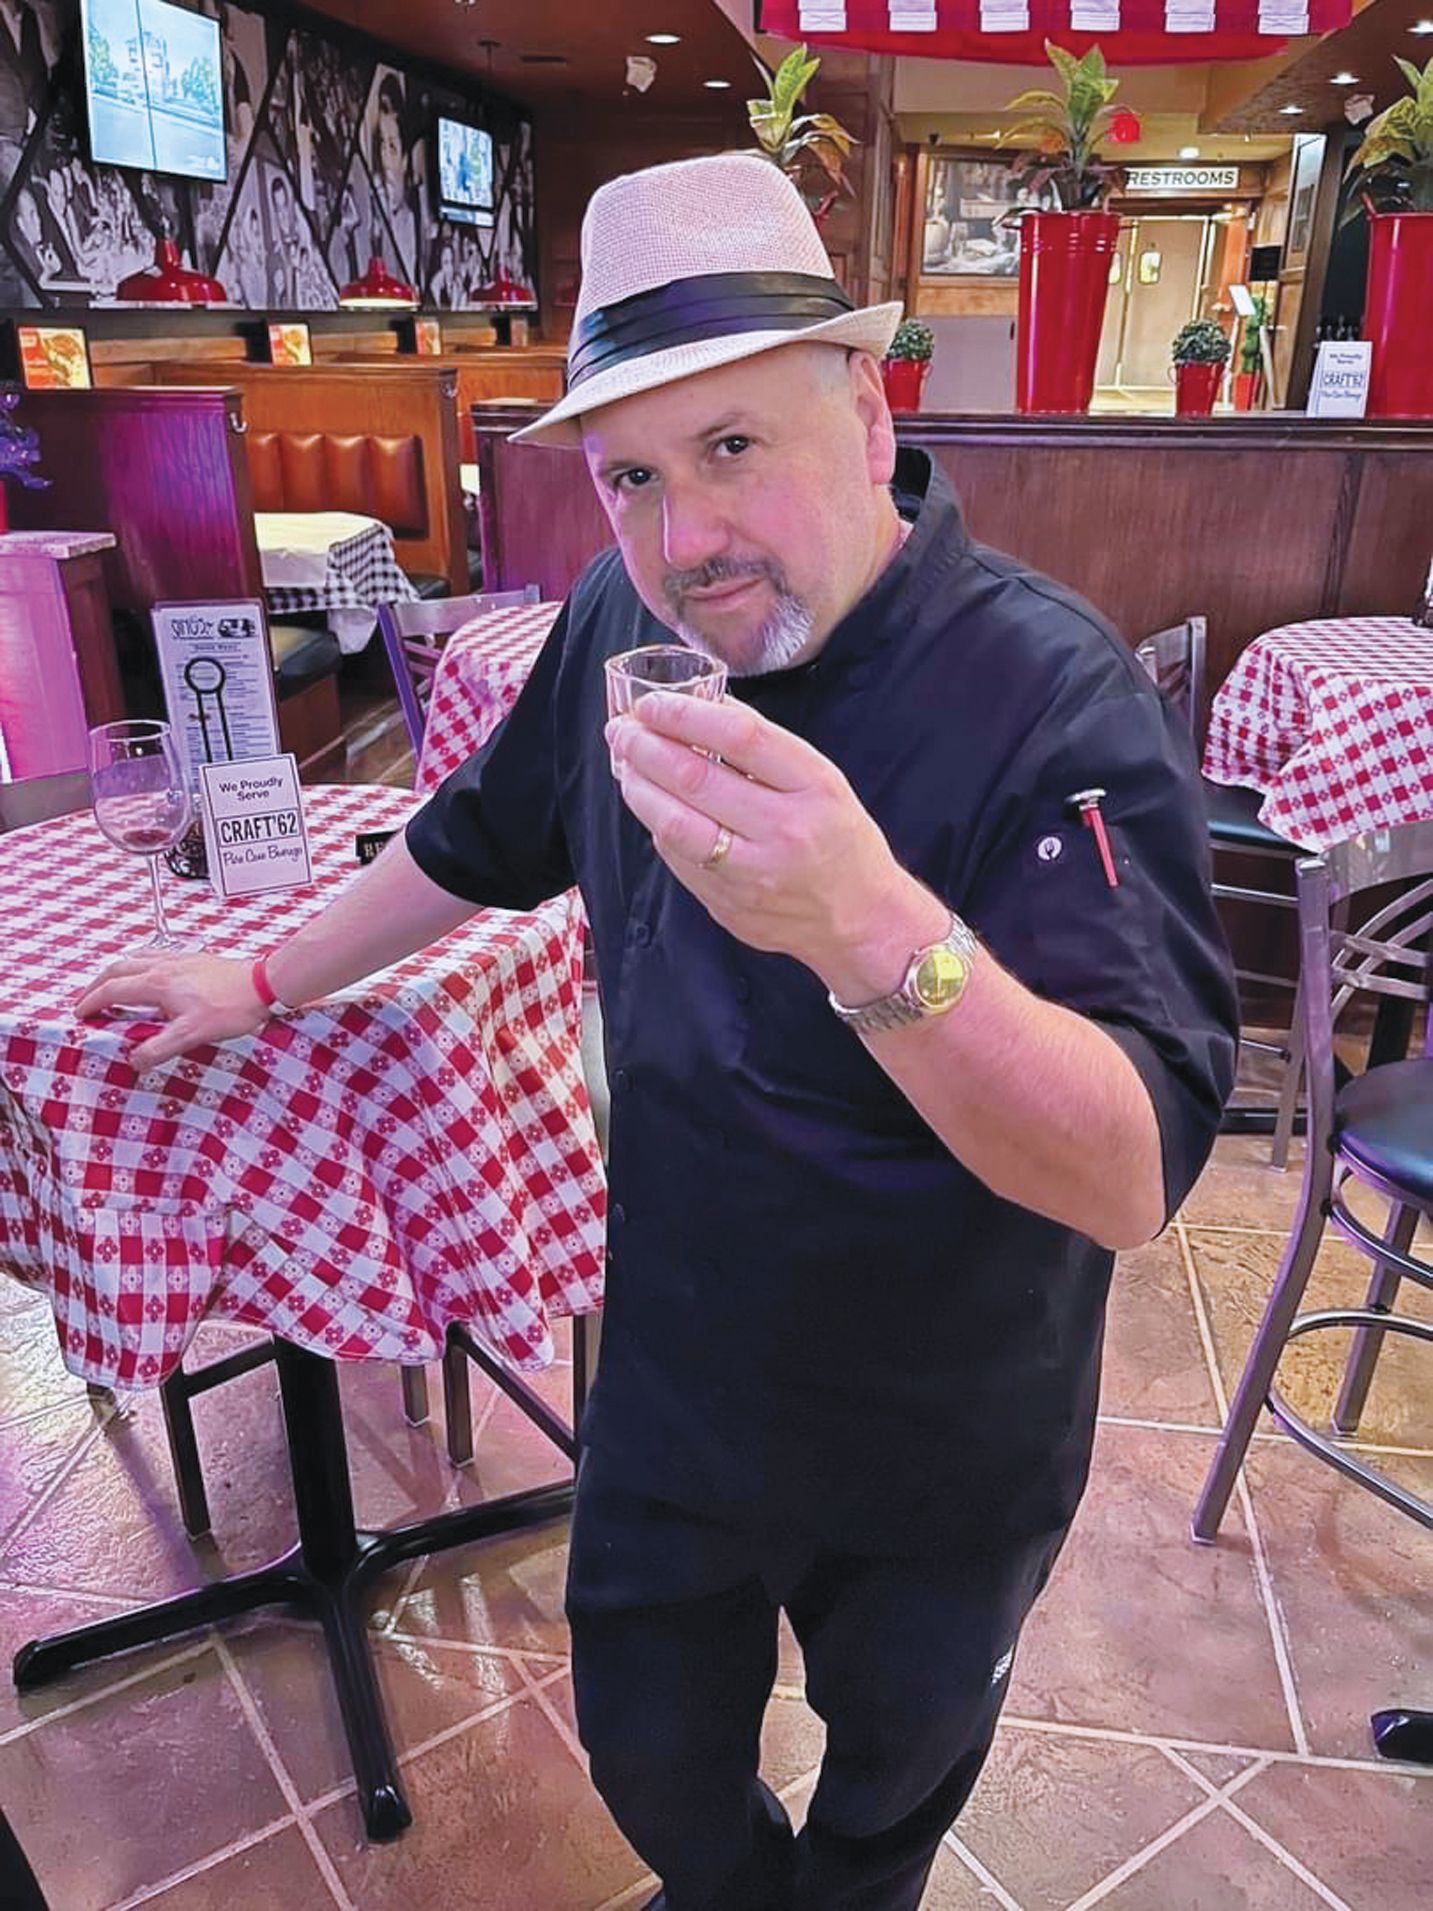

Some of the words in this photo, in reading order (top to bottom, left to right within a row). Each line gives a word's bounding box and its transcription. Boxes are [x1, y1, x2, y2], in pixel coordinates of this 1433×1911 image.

[1126, 171, 1235, 185] RESTROOMS
[219, 783, 238, 792] We
[240, 776, 283, 790] Proudly
[237, 790, 269, 801] Serve
[220, 812, 298, 843] CRAFT'62
